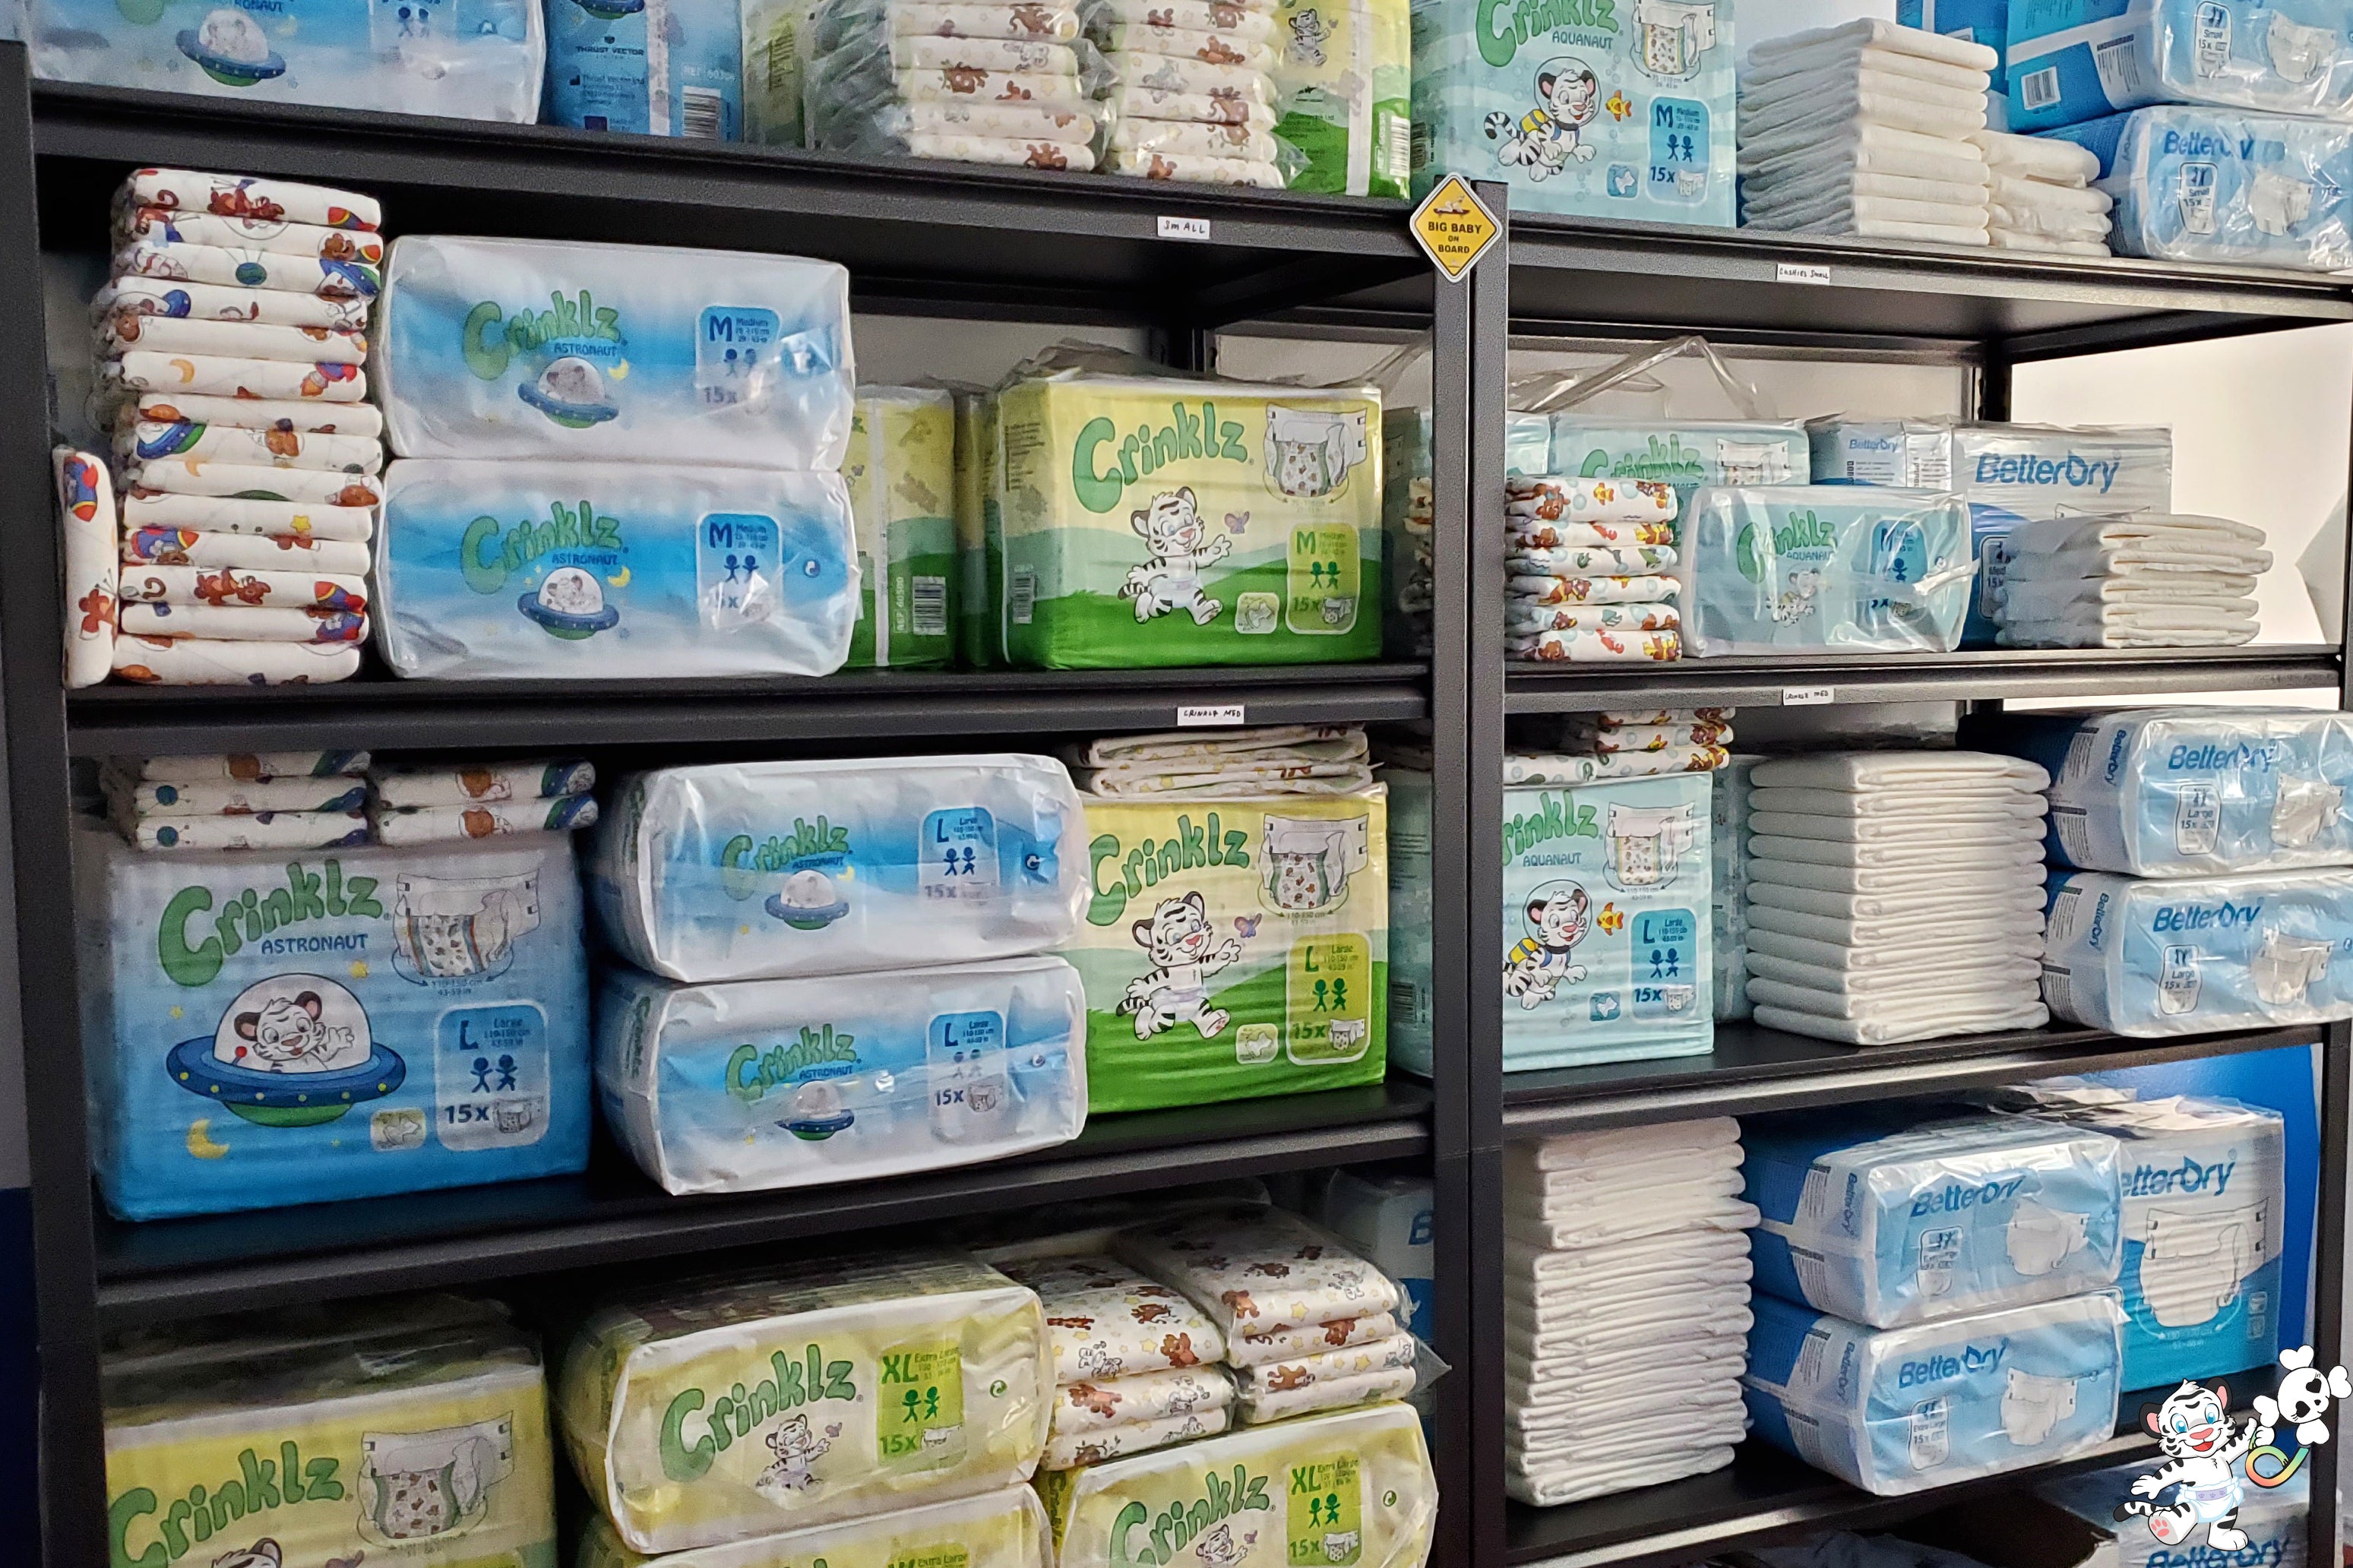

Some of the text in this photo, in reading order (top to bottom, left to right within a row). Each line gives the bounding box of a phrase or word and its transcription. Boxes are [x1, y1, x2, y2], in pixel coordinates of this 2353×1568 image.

[1475, 0, 1619, 68] Crinklz
[1552, 30, 1614, 50] AQUANAUT
[2198, 39, 2212, 49] 15x
[612, 48, 645, 56] VECTOR
[1656, 104, 1673, 128] M
[1650, 166, 1675, 185] 15x
[2183, 198, 2202, 207] 15x
[1428, 221, 1482, 235] BIG BABY
[1438, 245, 1470, 254] BOARD
[710, 315, 732, 342] M
[736, 317, 768, 327] Medium
[463, 290, 621, 381] Crinklz
[554, 343, 618, 357] ASTRONAUT
[1849, 438, 1898, 453] BetterDry
[1072, 402, 1248, 514] Crinklz
[1975, 450, 2120, 494] BetterDry
[460, 500, 623, 594] Crinklz
[710, 522, 732, 548] M
[1296, 531, 1316, 555] M
[552, 552, 618, 565] ASTRONAUT
[2168, 741, 2274, 773] BetterDry
[937, 818, 950, 843] L
[1502, 789, 1599, 866] rinklz
[2181, 819, 2197, 830] 15x
[721, 814, 849, 901] Crinklz
[792, 855, 845, 869] ASTRONAUT
[1086, 812, 1250, 926] Crinklz
[1523, 852, 1582, 867] AQUANAUT
[925, 884, 957, 898] 15x
[158, 858, 382, 987] Crinklz
[2089, 892, 2110, 951] BetterDry
[2153, 900, 2260, 932] BetterDry
[1643, 919, 1656, 944] L
[261, 933, 368, 955] ASTRONAUT
[1331, 944, 1354, 954] Large
[1305, 945, 1320, 972] L
[2164, 980, 2180, 990] 15x
[2171, 968, 2195, 980] Large
[1635, 987, 1662, 1003] 15x
[494, 1018, 523, 1028] Large
[944, 1023, 959, 1047] L
[1292, 1023, 1326, 1040] 15x
[460, 1020, 479, 1051] L
[726, 1023, 858, 1102] Crinklz
[799, 1065, 853, 1080] ASTRONAUT
[936, 1088, 964, 1106] 15x
[444, 1104, 490, 1124] 15x
[1910, 1178, 2023, 1217] BetterDry
[881, 1353, 919, 1384] XL
[915, 1353, 938, 1363] Extra
[1899, 1345, 2006, 1389] BetterDry
[659, 1343, 858, 1483] Crinklz
[880, 1434, 916, 1454] 15x
[1292, 1465, 1322, 1496] XL
[1337, 1459, 1358, 1469] Large
[106, 1440, 344, 1568] Crinklz
[1109, 1464, 1270, 1568] Crinklz
[1290, 1538, 1320, 1558] 15x
